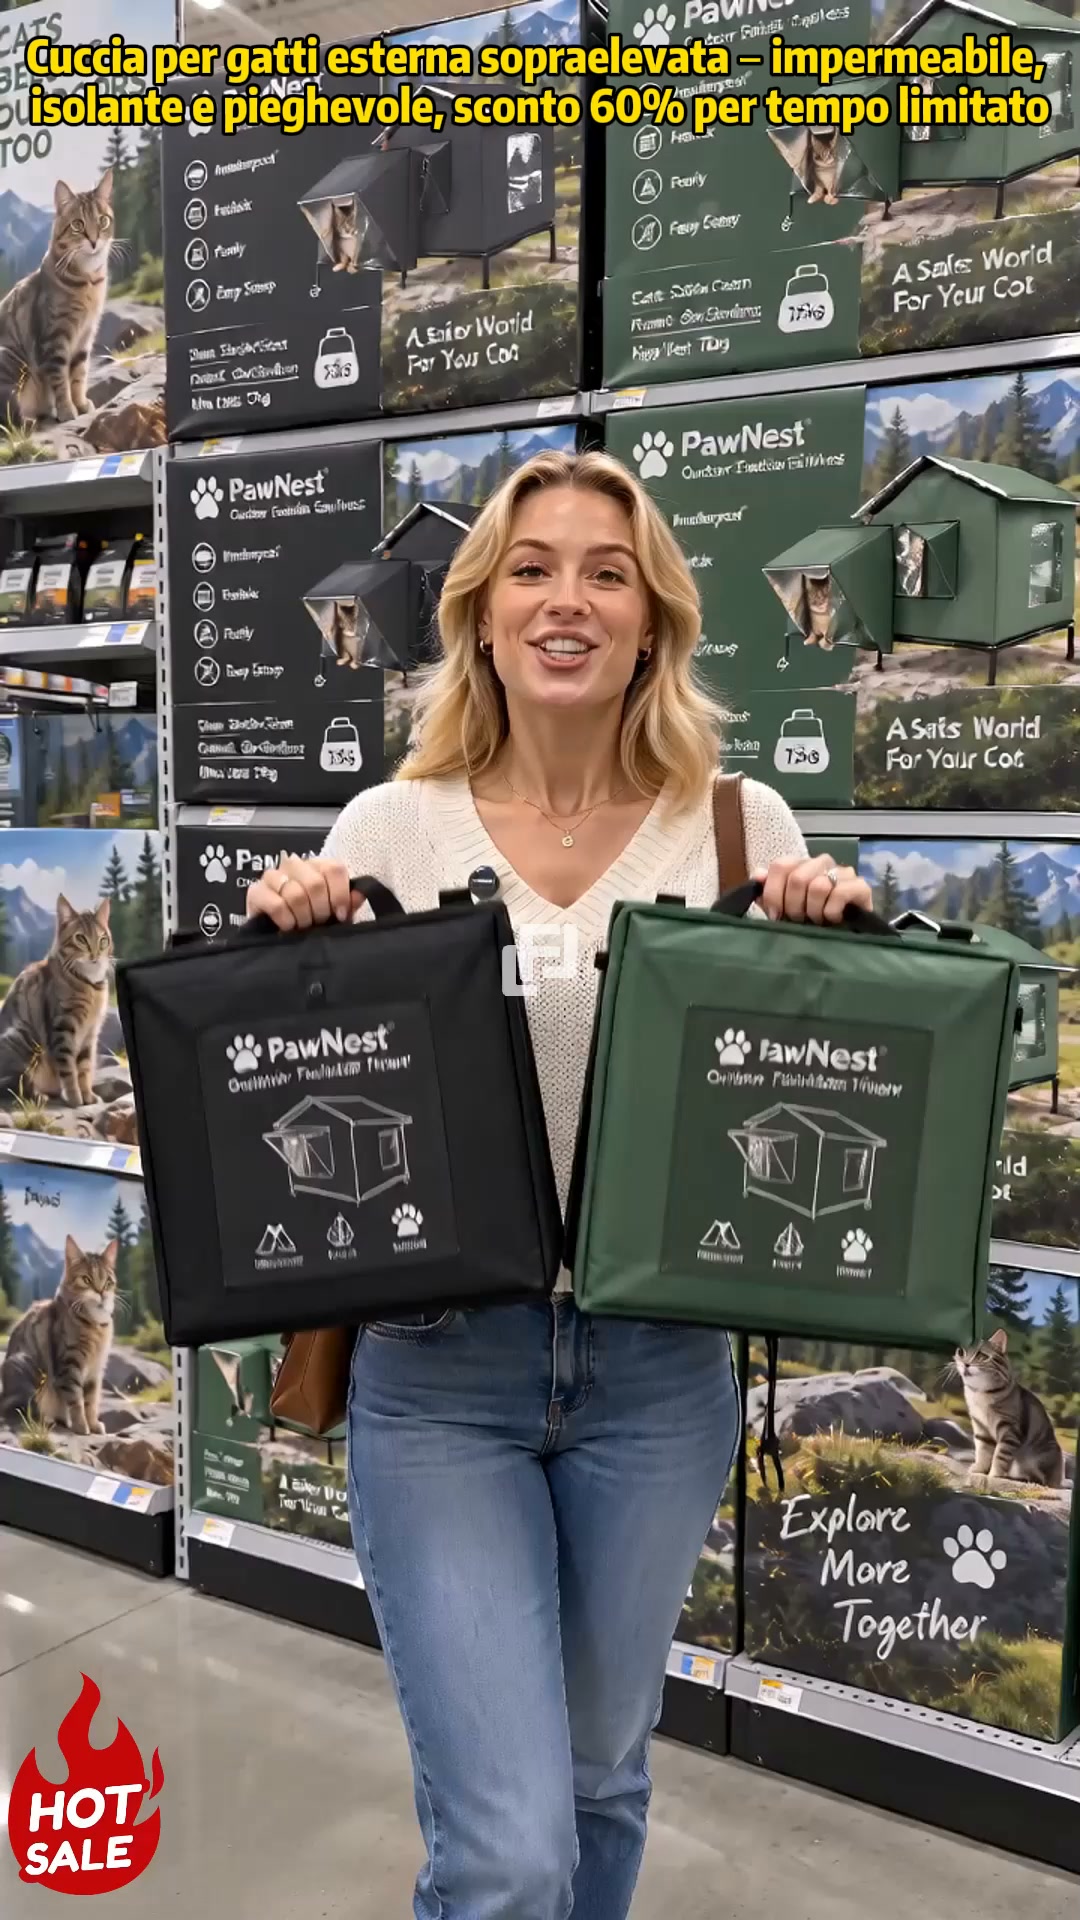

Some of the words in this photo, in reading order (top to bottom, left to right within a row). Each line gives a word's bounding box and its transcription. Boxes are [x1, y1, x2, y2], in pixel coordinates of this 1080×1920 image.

[0, 129, 52, 168] TOO
[892, 263, 913, 286] A
[893, 290, 932, 313] For
[682, 419, 806, 457] PawNest
[229, 470, 325, 503] PawNest
[886, 716, 908, 741] A
[886, 746, 922, 771] For
[268, 1023, 388, 1063] PawNest
[781, 1492, 911, 1544] Explore
[820, 1549, 911, 1587] More
[833, 1597, 988, 1660] Together
